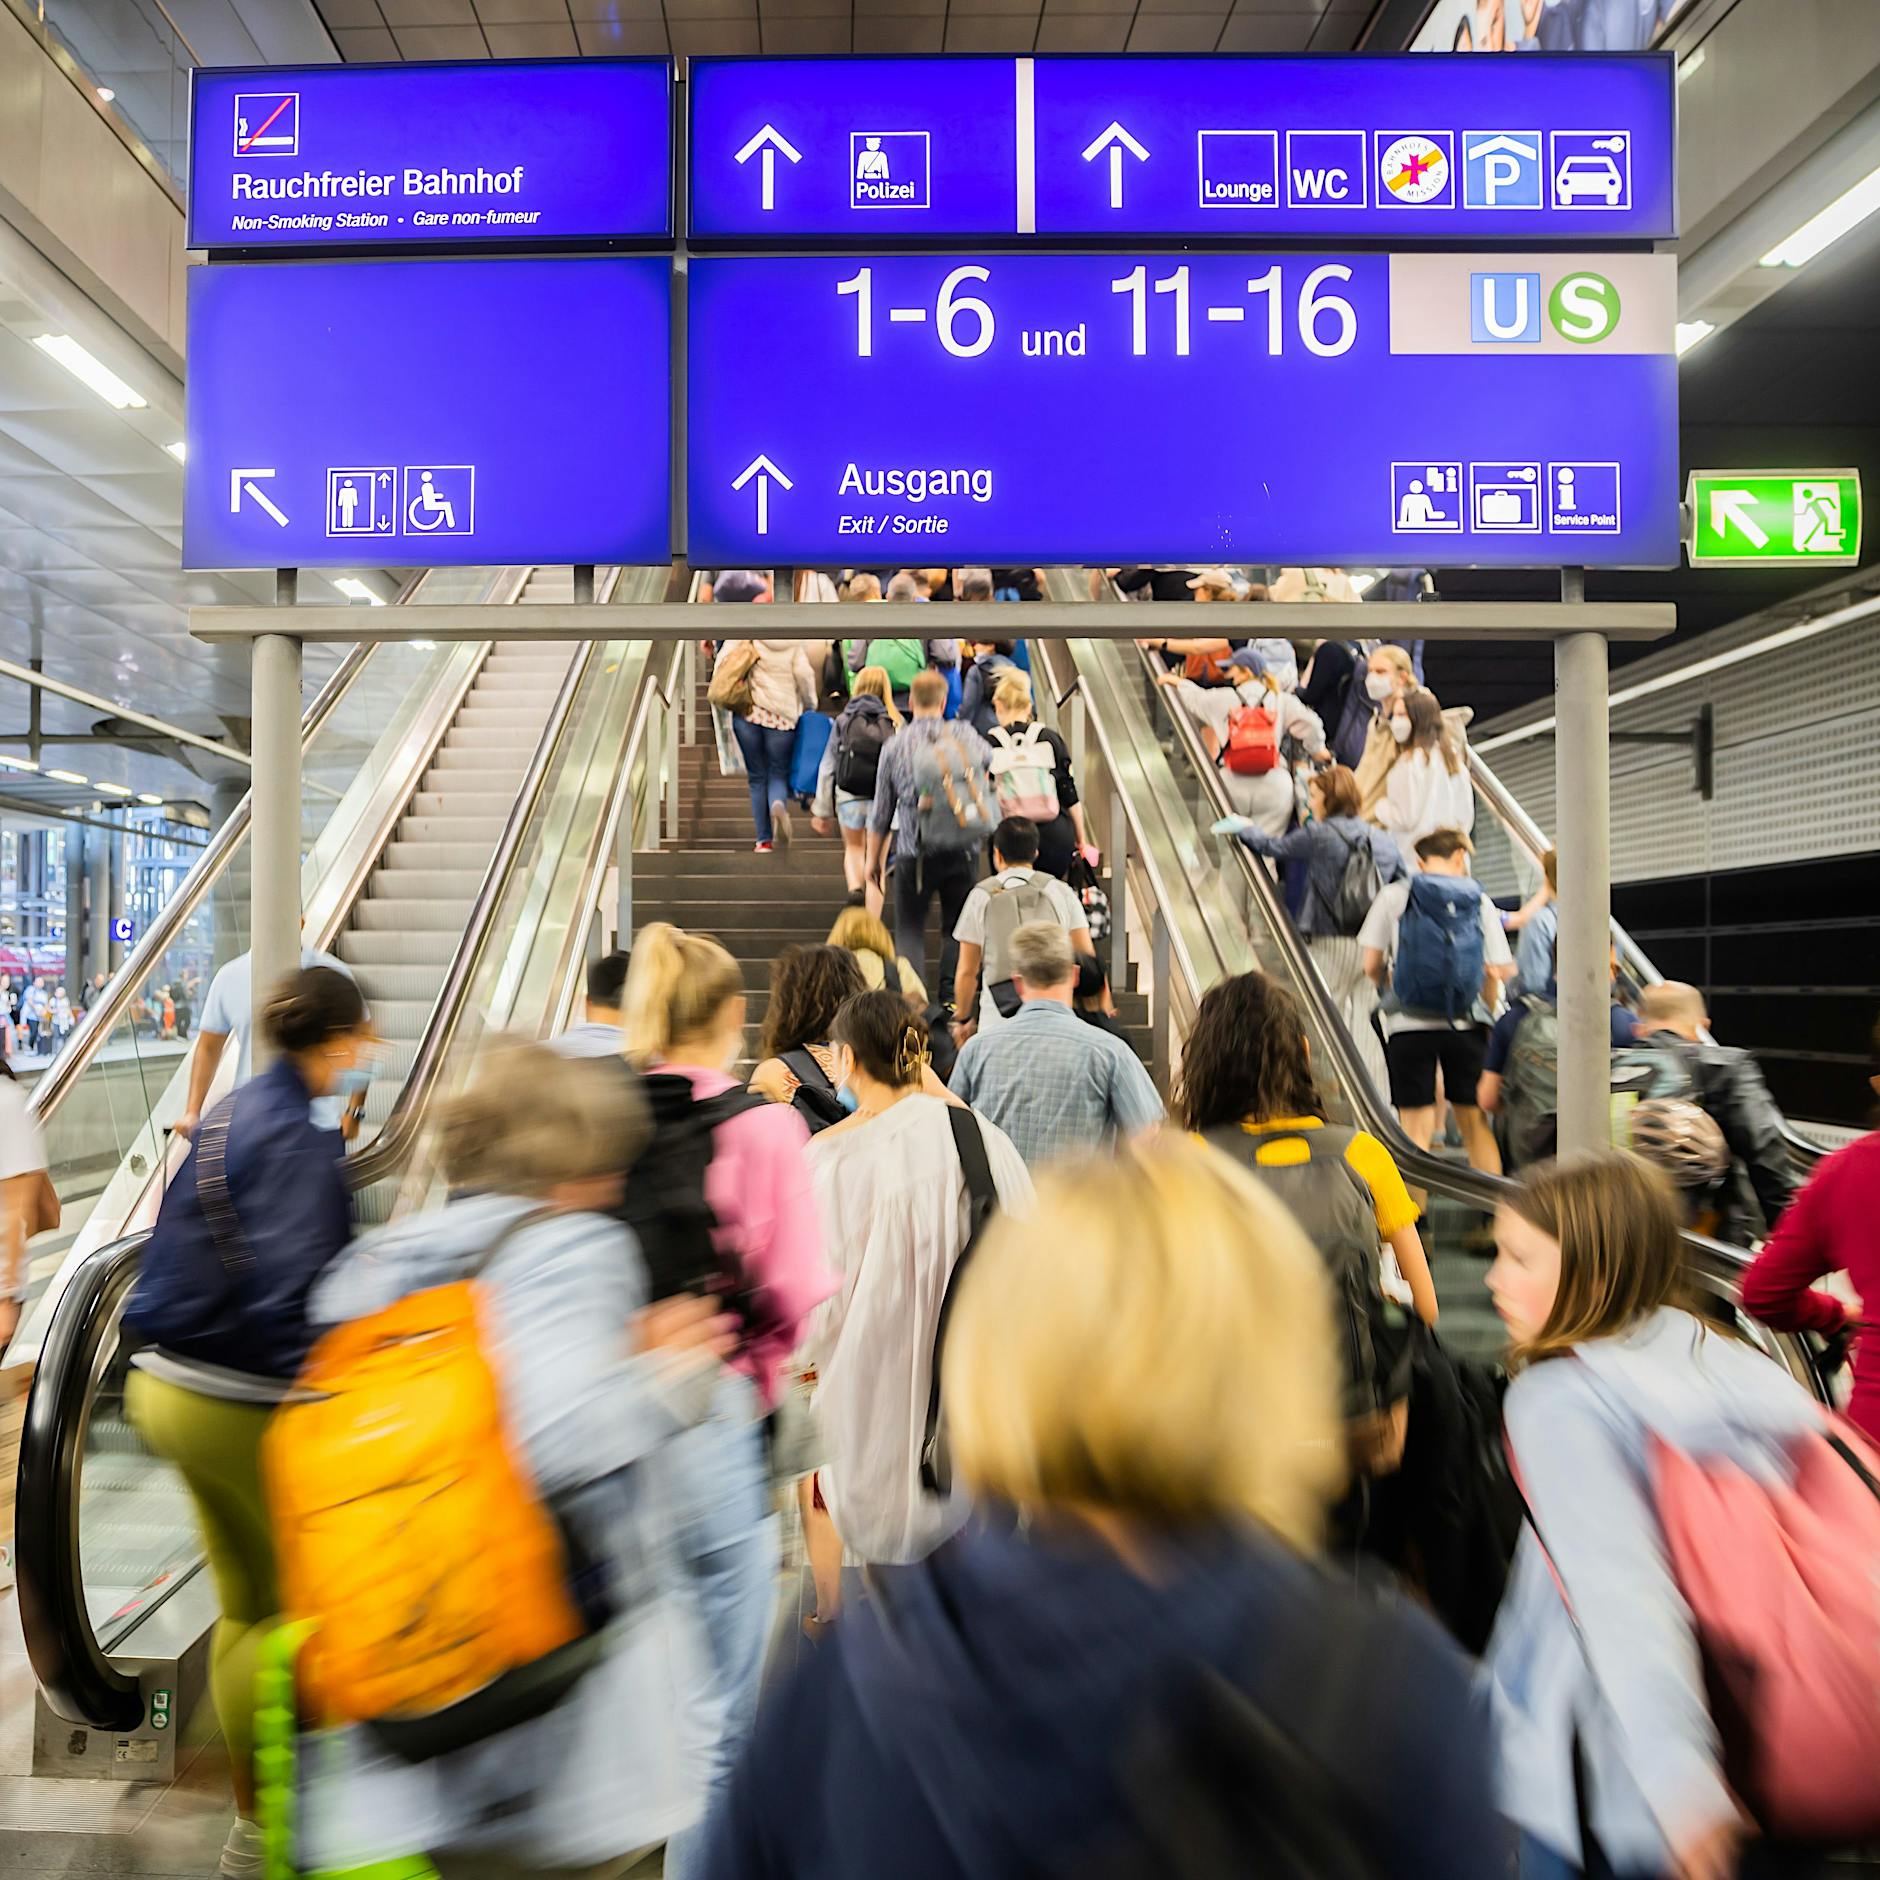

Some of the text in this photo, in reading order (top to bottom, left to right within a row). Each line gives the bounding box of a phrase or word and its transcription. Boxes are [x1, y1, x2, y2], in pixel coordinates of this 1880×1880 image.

[233, 167, 523, 199] Rauchfreier Bahnhof
[857, 182, 914, 198] Polizei
[1206, 180, 1272, 202] Lounge
[1293, 169, 1348, 198] WC
[1406, 170, 1442, 197] MISSION
[1486, 155, 1520, 205] P
[232, 210, 540, 231] Non-Smoking Station Gare non-fumeur
[1484, 278, 1609, 339] U S
[1023, 324, 1085, 356] und
[839, 464, 991, 502] Ausgang
[839, 516, 874, 533] Exit
[892, 516, 948, 533] Sortie
[1554, 514, 1615, 525] Service Point
[116, 919, 131, 939] C
